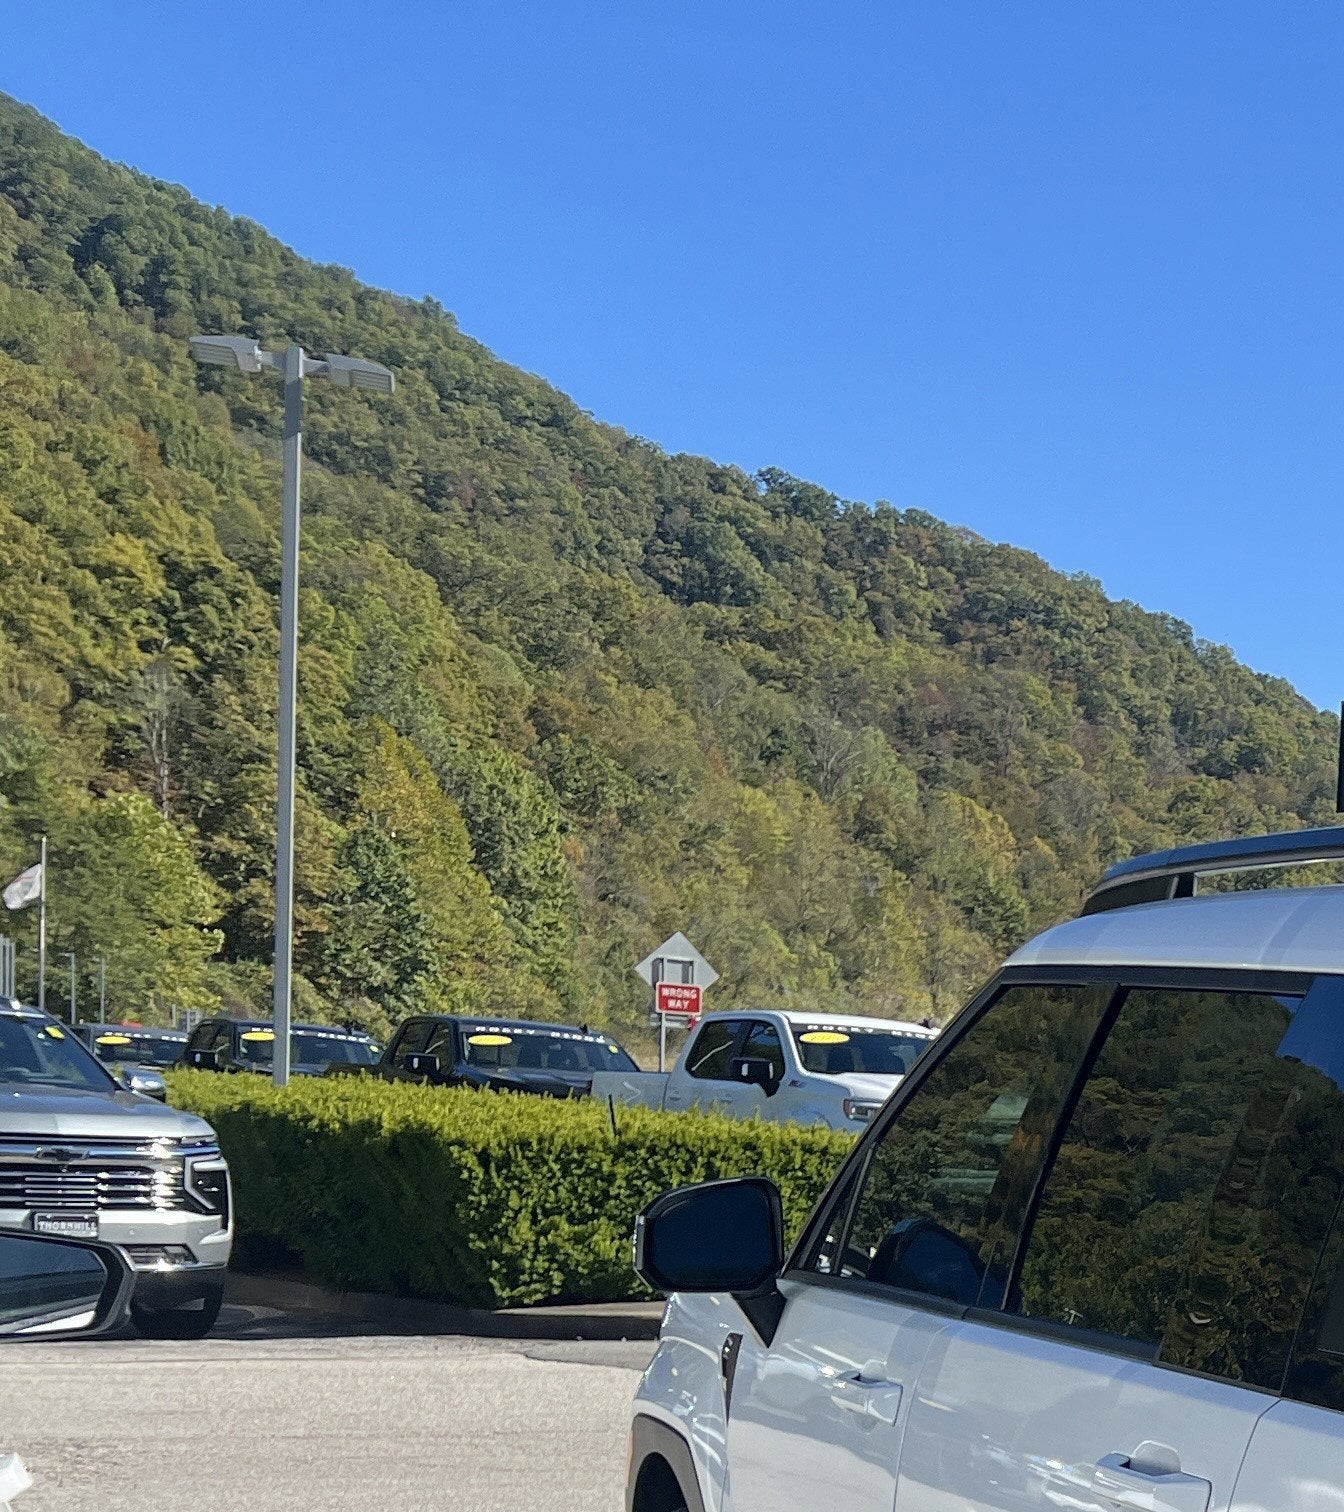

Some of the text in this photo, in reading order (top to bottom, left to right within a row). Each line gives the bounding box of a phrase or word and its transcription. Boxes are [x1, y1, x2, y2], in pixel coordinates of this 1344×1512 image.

[661, 987, 698, 999] WRONG
[667, 1000, 690, 1010] WAY
[37, 1221, 97, 1231] THORNHILL
